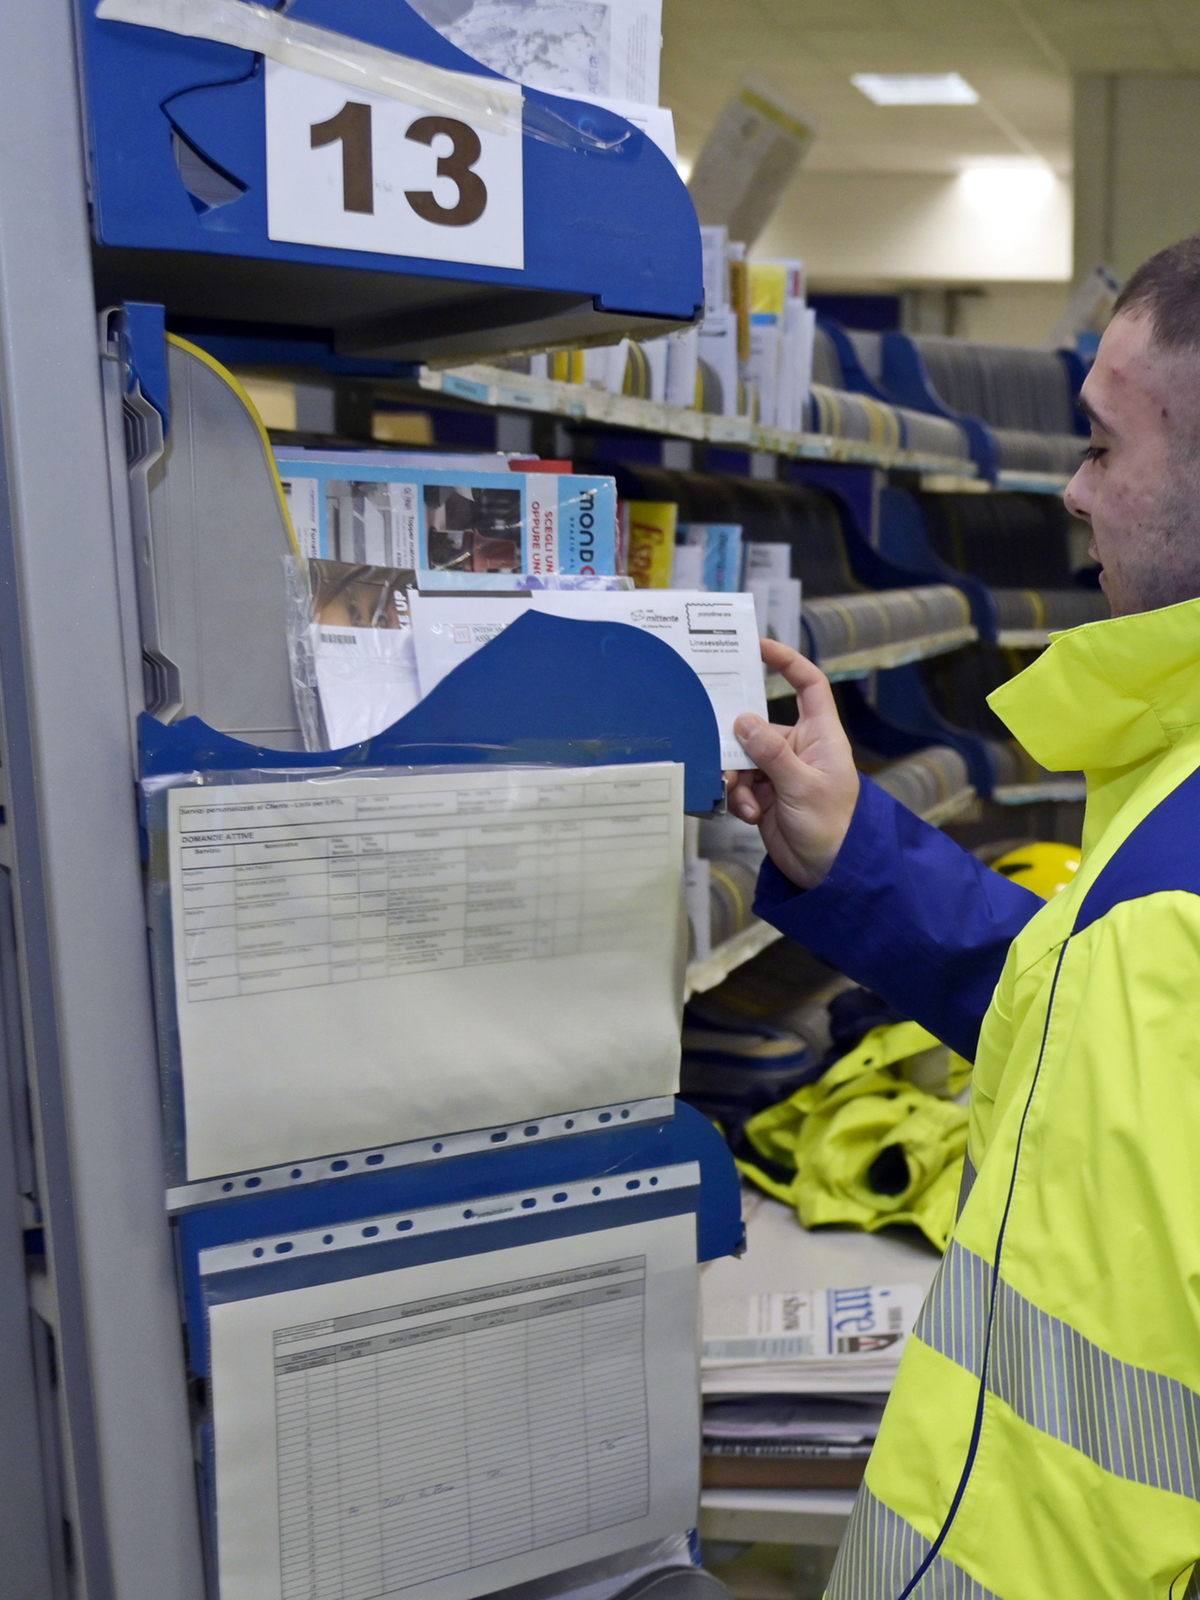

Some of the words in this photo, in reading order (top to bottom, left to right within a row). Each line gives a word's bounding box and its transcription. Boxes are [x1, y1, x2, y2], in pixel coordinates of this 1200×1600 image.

[309, 101, 488, 227] 13
[531, 501, 541, 549] OPPURE
[544, 510, 554, 553] SCEGLI
[393, 589, 408, 612] UP
[181, 834, 224, 843] DOMANDE
[226, 832, 254, 840] ATTIVE
